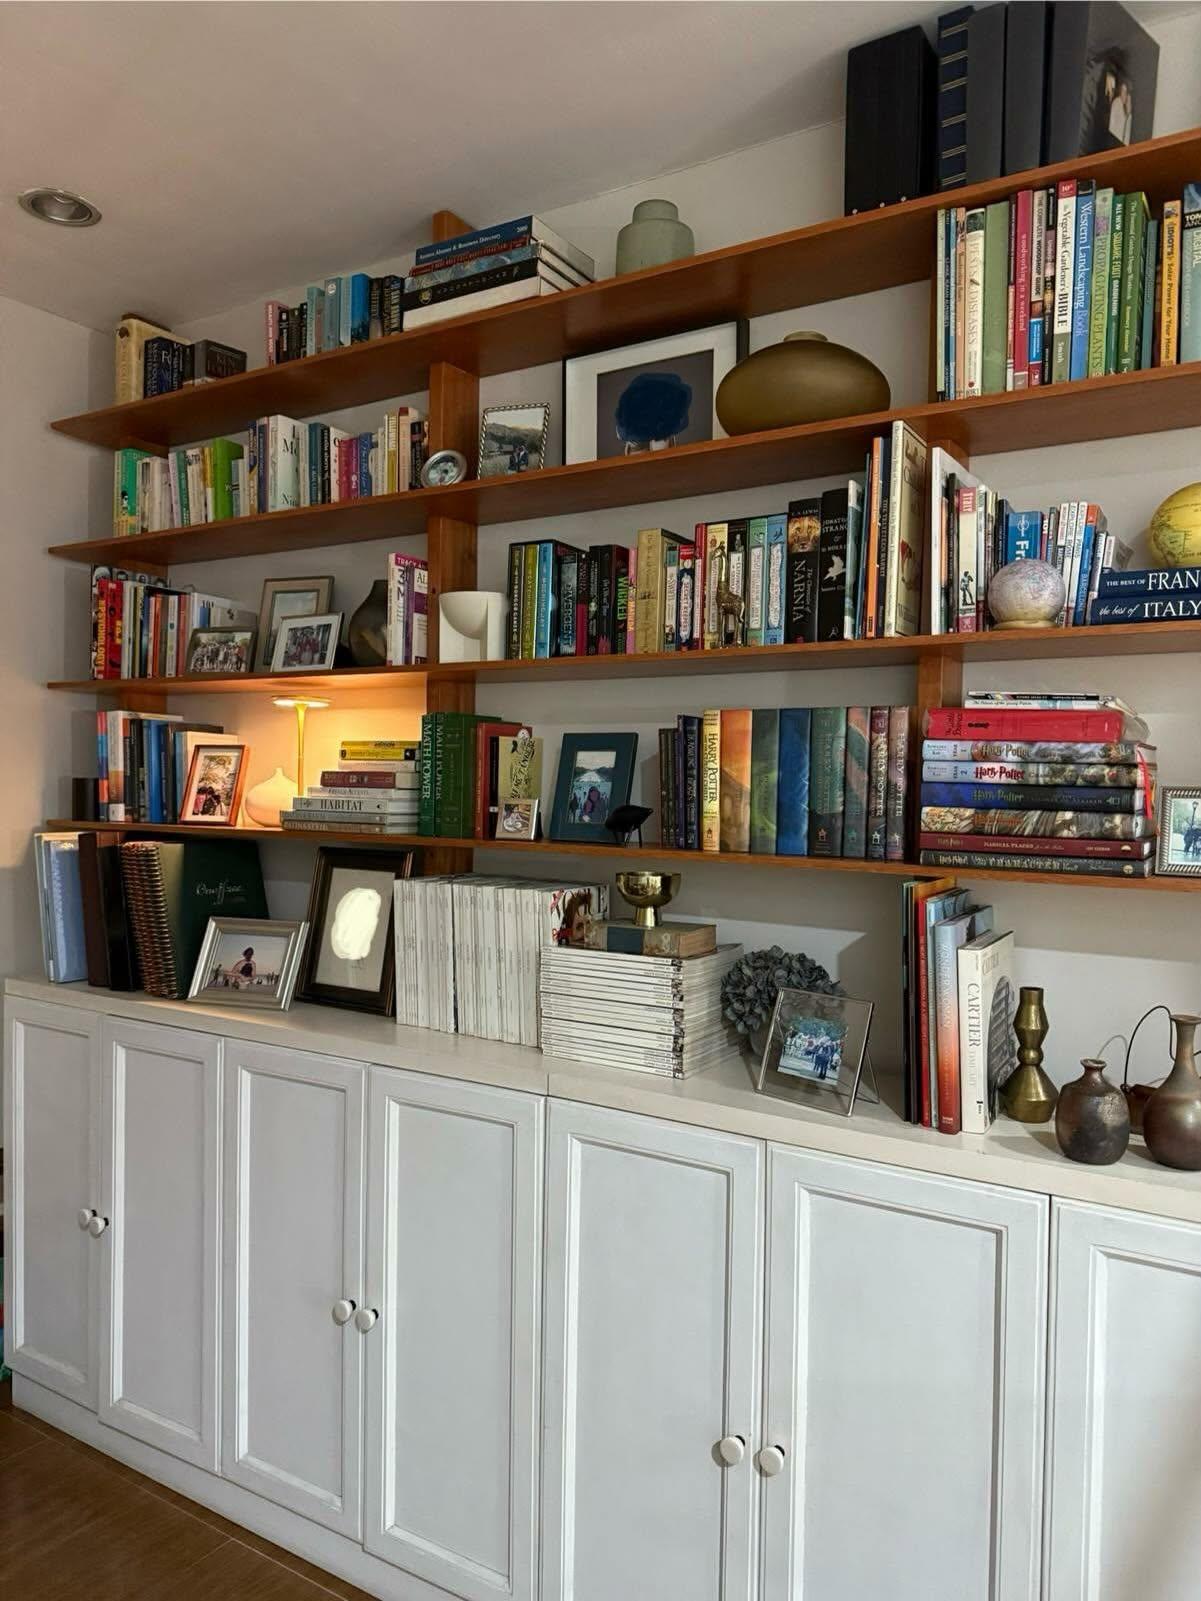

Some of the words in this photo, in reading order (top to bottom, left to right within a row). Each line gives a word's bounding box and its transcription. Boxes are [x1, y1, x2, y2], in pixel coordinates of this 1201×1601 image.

[1060, 210, 1070, 250] Vegetable
[1080, 202, 1092, 244] Western
[1167, 226, 1175, 257] IDIOT'S
[968, 242, 980, 277] PESTS
[1018, 234, 1028, 283] woodworking
[1112, 232, 1122, 260] SQUARE
[1192, 230, 1201, 268] DIGITAL
[1060, 252, 1070, 292] Gardener's
[1075, 246, 1091, 308] Landscaping
[1093, 236, 1107, 321] PROPAGATING
[1112, 261, 1122, 279] FOOT
[967, 292, 979, 345] DISEASES
[1057, 293, 1069, 328] BIBLE
[1075, 310, 1088, 337] Book
[1091, 324, 1103, 370] PLANTS
[1068, 506, 1076, 536] EXPLORE
[1077, 504, 1085, 536] EXPLORE
[1064, 540, 1072, 558] ROME
[1074, 538, 1082, 558] PARIS
[617, 576, 628, 620] WICKED
[792, 560, 806, 623] NARNIA
[1078, 574, 1088, 612] BARCELONA
[1106, 580, 1119, 588] THE
[563, 583, 573, 646] DIVERGENT
[1099, 606, 1111, 616] the
[1112, 606, 1126, 615] best
[1127, 604, 1140, 618] of
[1143, 600, 1201, 618] ITALY
[98, 607, 106, 665] PSYCHOLOGY
[423, 724, 432, 757] MATH
[708, 733, 718, 764] HARRY
[876, 732, 887, 774] HARRY
[895, 732, 906, 774] HARRY
[980, 744, 1004, 758] Harry
[1005, 744, 1031, 759] Potter
[422, 759, 431, 798] POWER
[708, 767, 718, 804] POTTER
[974, 766, 998, 778] Harry
[999, 766, 1026, 780] Potter
[320, 799, 364, 811] HABITAT
[876, 777, 886, 817] POTTER
[895, 778, 906, 817] POTTER
[972, 790, 996, 800] Harry
[997, 789, 1024, 802] Potter
[942, 944, 952, 984] WONDER
[943, 987, 953, 1030] WOMAN
[967, 983, 982, 1047] CARTIER
